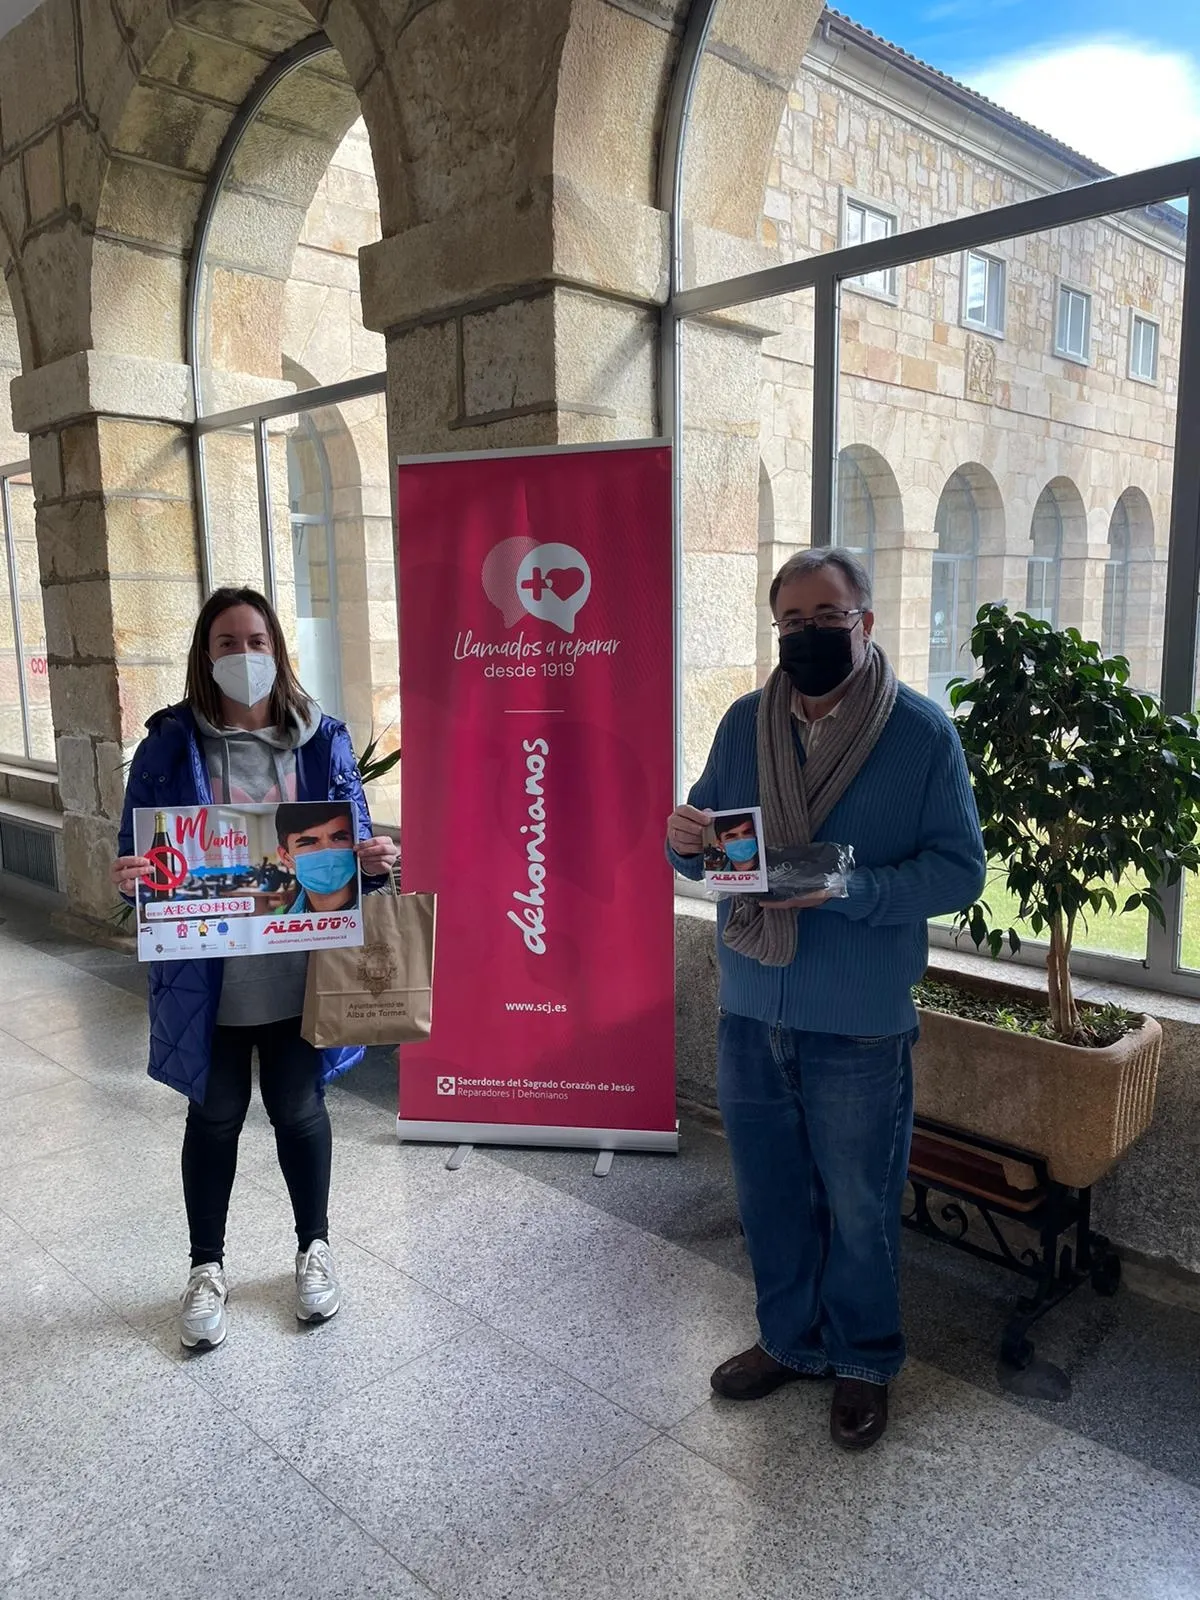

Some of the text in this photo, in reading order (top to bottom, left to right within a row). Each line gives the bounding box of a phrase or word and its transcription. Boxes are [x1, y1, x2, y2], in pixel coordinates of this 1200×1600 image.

[454, 629, 621, 662] Llamados a reparar
[484, 662, 575, 678] desde 1919
[507, 738, 549, 955] dehonianos
[711, 873, 736, 881] ALBA
[163, 900, 252, 916] ALCOHOL
[263, 919, 313, 935] ALBA
[346, 1009, 406, 1018] Alba de Tormes
[505, 1001, 567, 1014] www.scj.es
[457, 1077, 635, 1092] Sacerdotes del Sagrado Corazón de Jesús
[457, 1087, 510, 1098] Reparadores
[517, 1089, 568, 1100] Dehonianos
